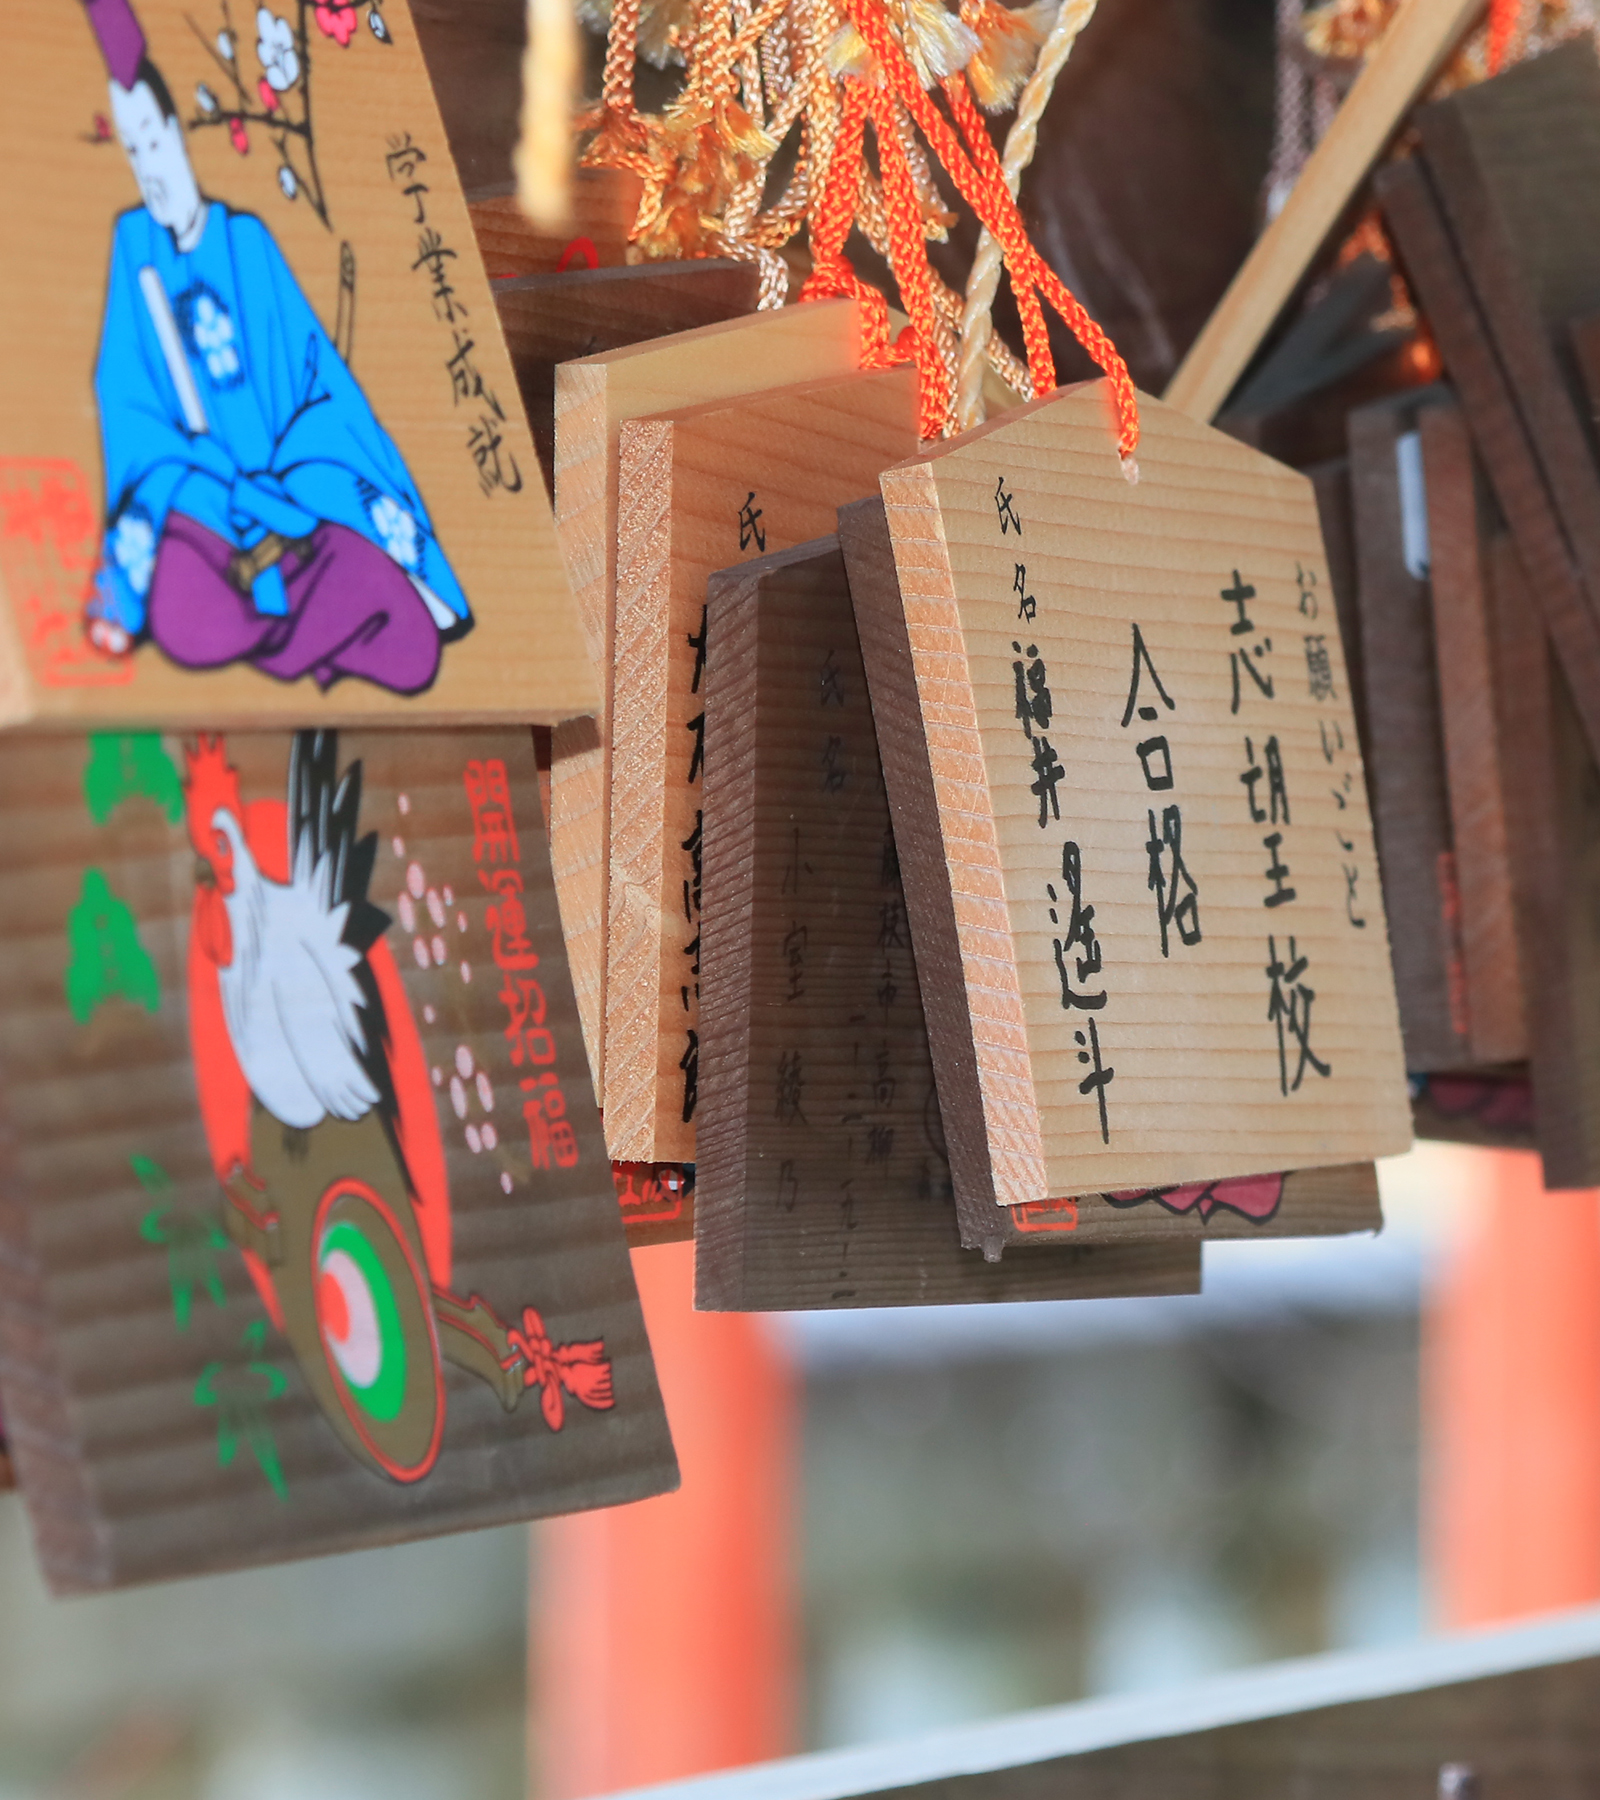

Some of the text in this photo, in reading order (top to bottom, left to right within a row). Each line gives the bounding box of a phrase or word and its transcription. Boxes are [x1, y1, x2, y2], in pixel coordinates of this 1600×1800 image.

[386, 134, 522, 497] 学業成就
[1120, 622, 1202, 959] 合格
[1220, 569, 1331, 1096] 志望校
[1295, 562, 1366, 929] お願いごと
[463, 758, 579, 1170] 開運招福
